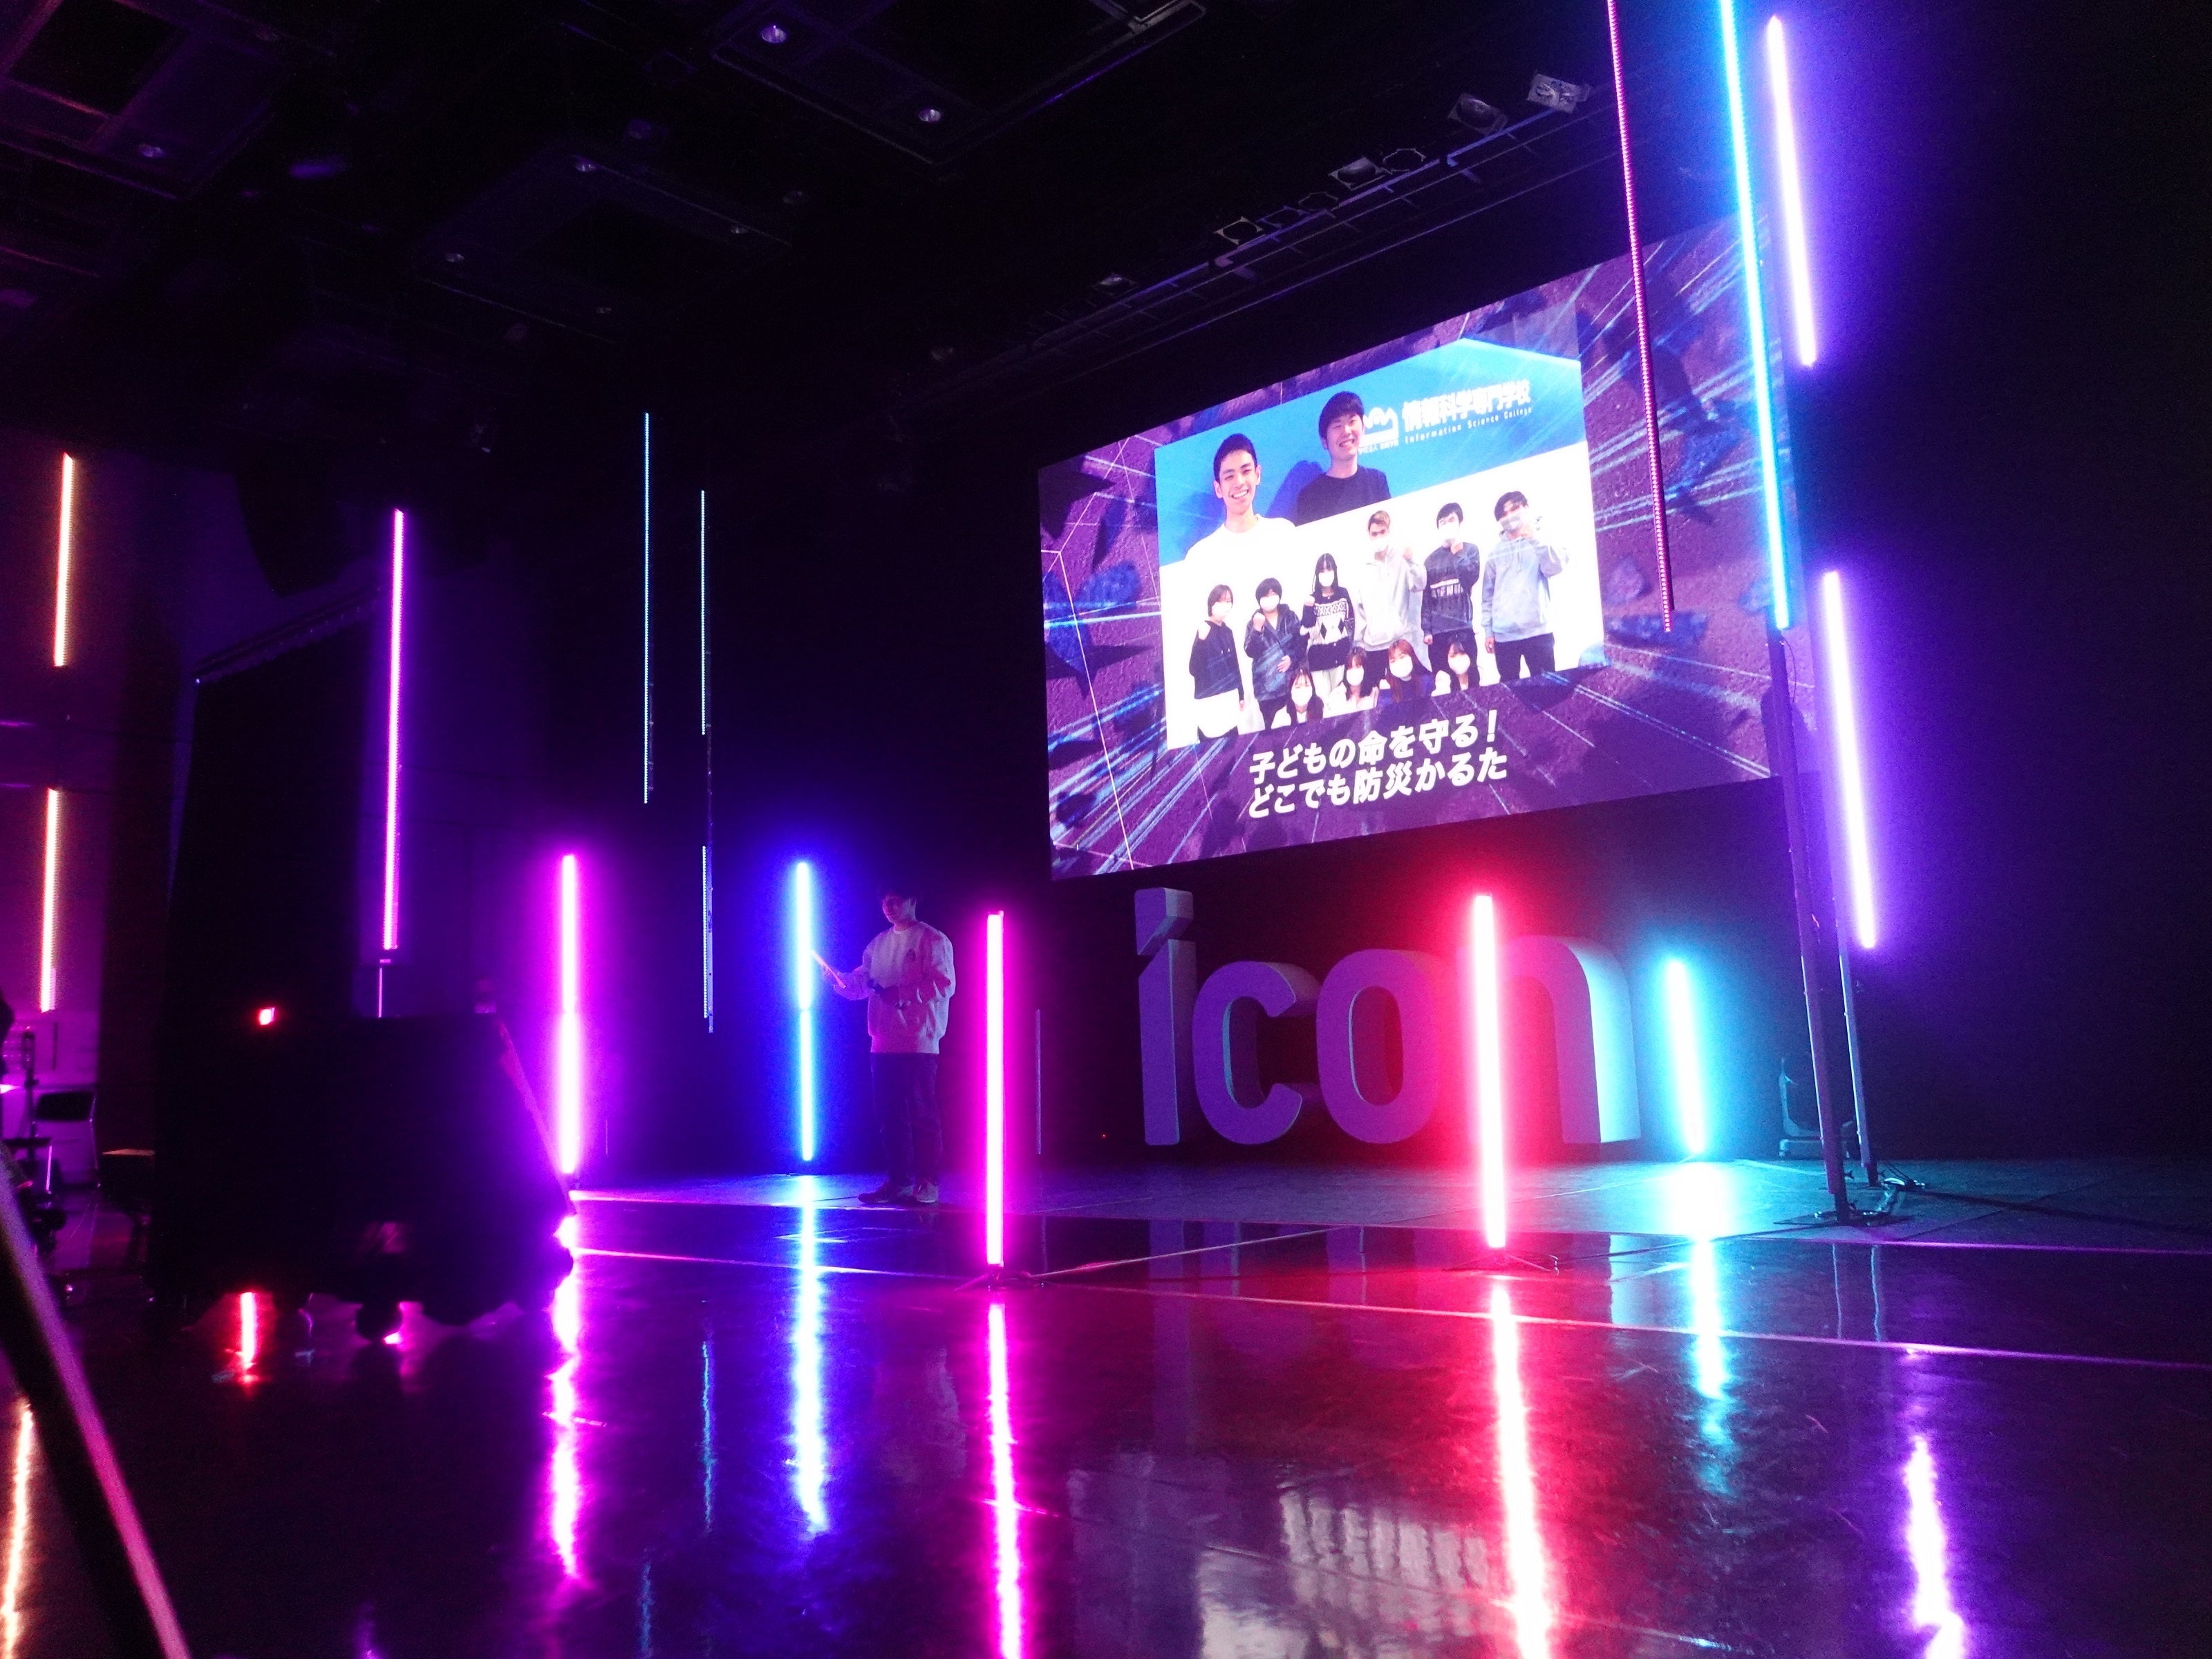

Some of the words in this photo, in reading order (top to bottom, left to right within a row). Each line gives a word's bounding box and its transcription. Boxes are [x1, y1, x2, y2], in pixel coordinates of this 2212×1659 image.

[1405, 424, 1462, 444] Information
[1467, 414, 1499, 429] Science
[1503, 406, 1532, 420] College
[1248, 747, 1508, 818] どこでも防災かるた
[1249, 709, 1498, 785] 子どもの命を守る！
[1134, 887, 1641, 1145] icon
